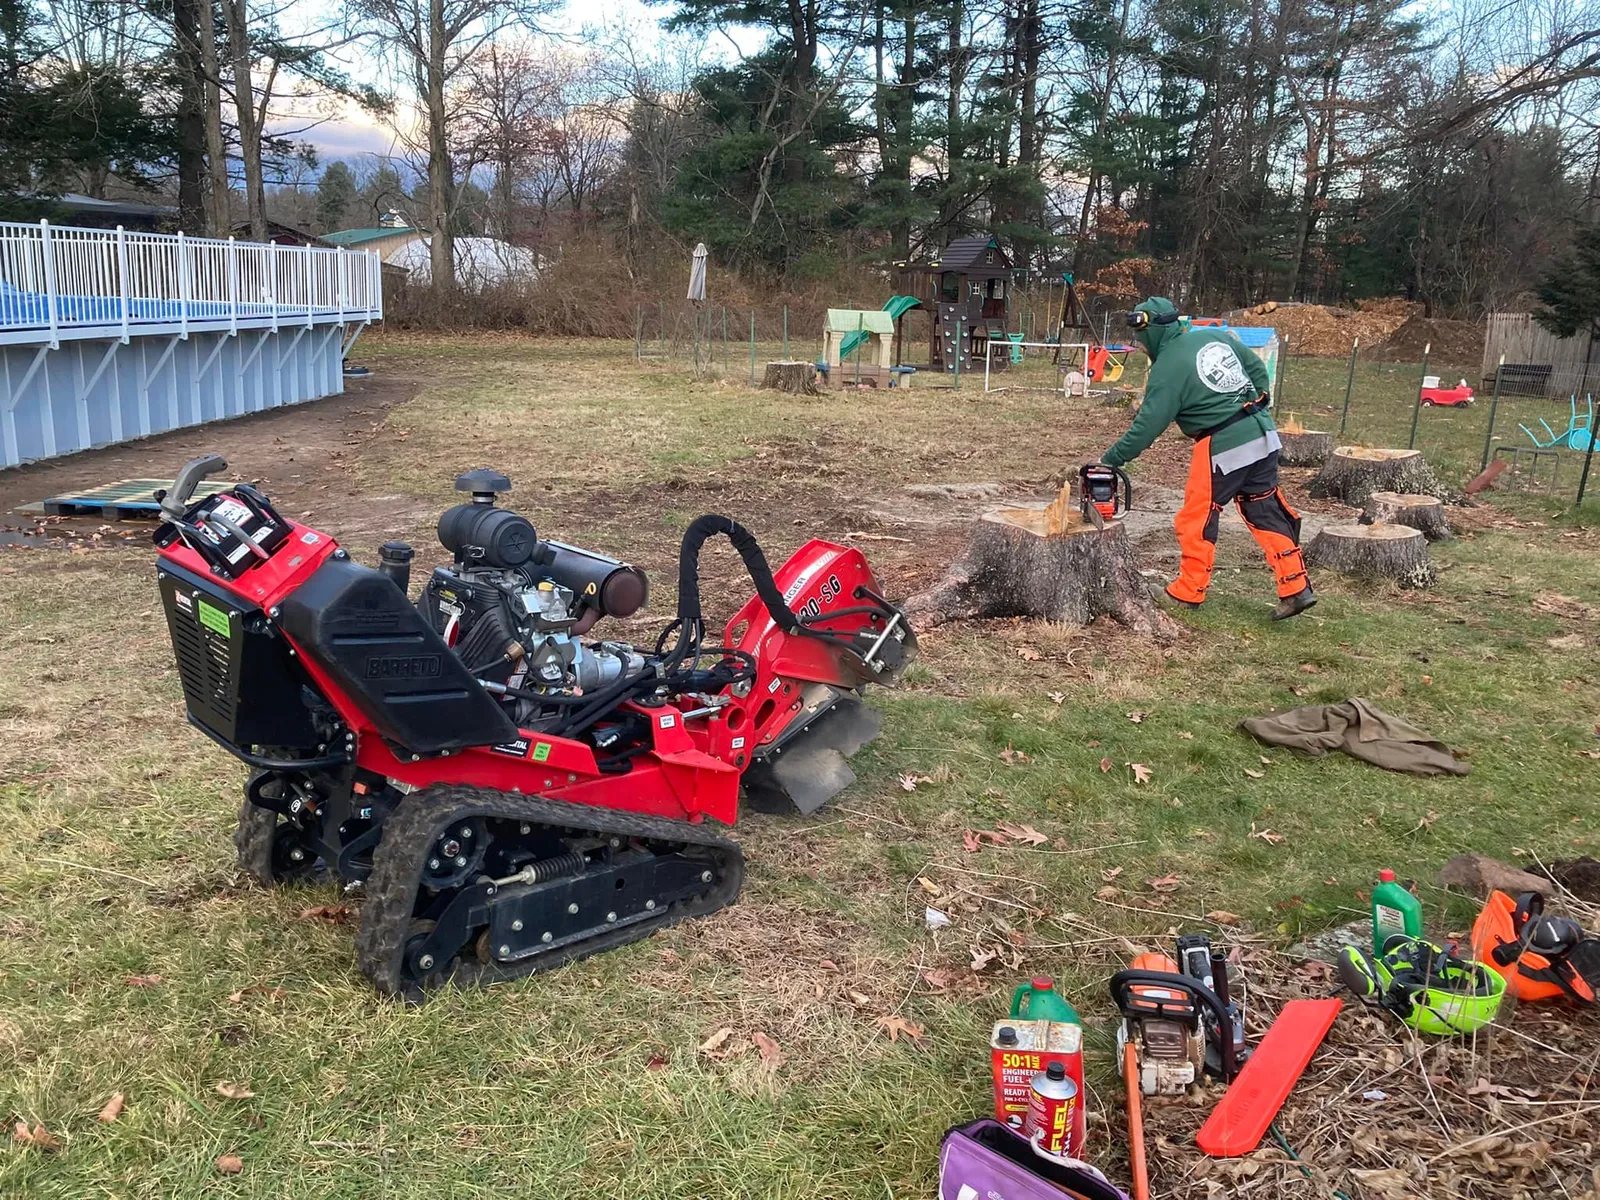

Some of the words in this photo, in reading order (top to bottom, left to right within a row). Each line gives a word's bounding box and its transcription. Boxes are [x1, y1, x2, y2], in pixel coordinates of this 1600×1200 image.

[1002, 1053, 1031, 1068] 50:1
[1003, 1075, 1024, 1083] FUEL
[1004, 1088, 1026, 1096] READY
[1050, 1101, 1068, 1151] FUEL
